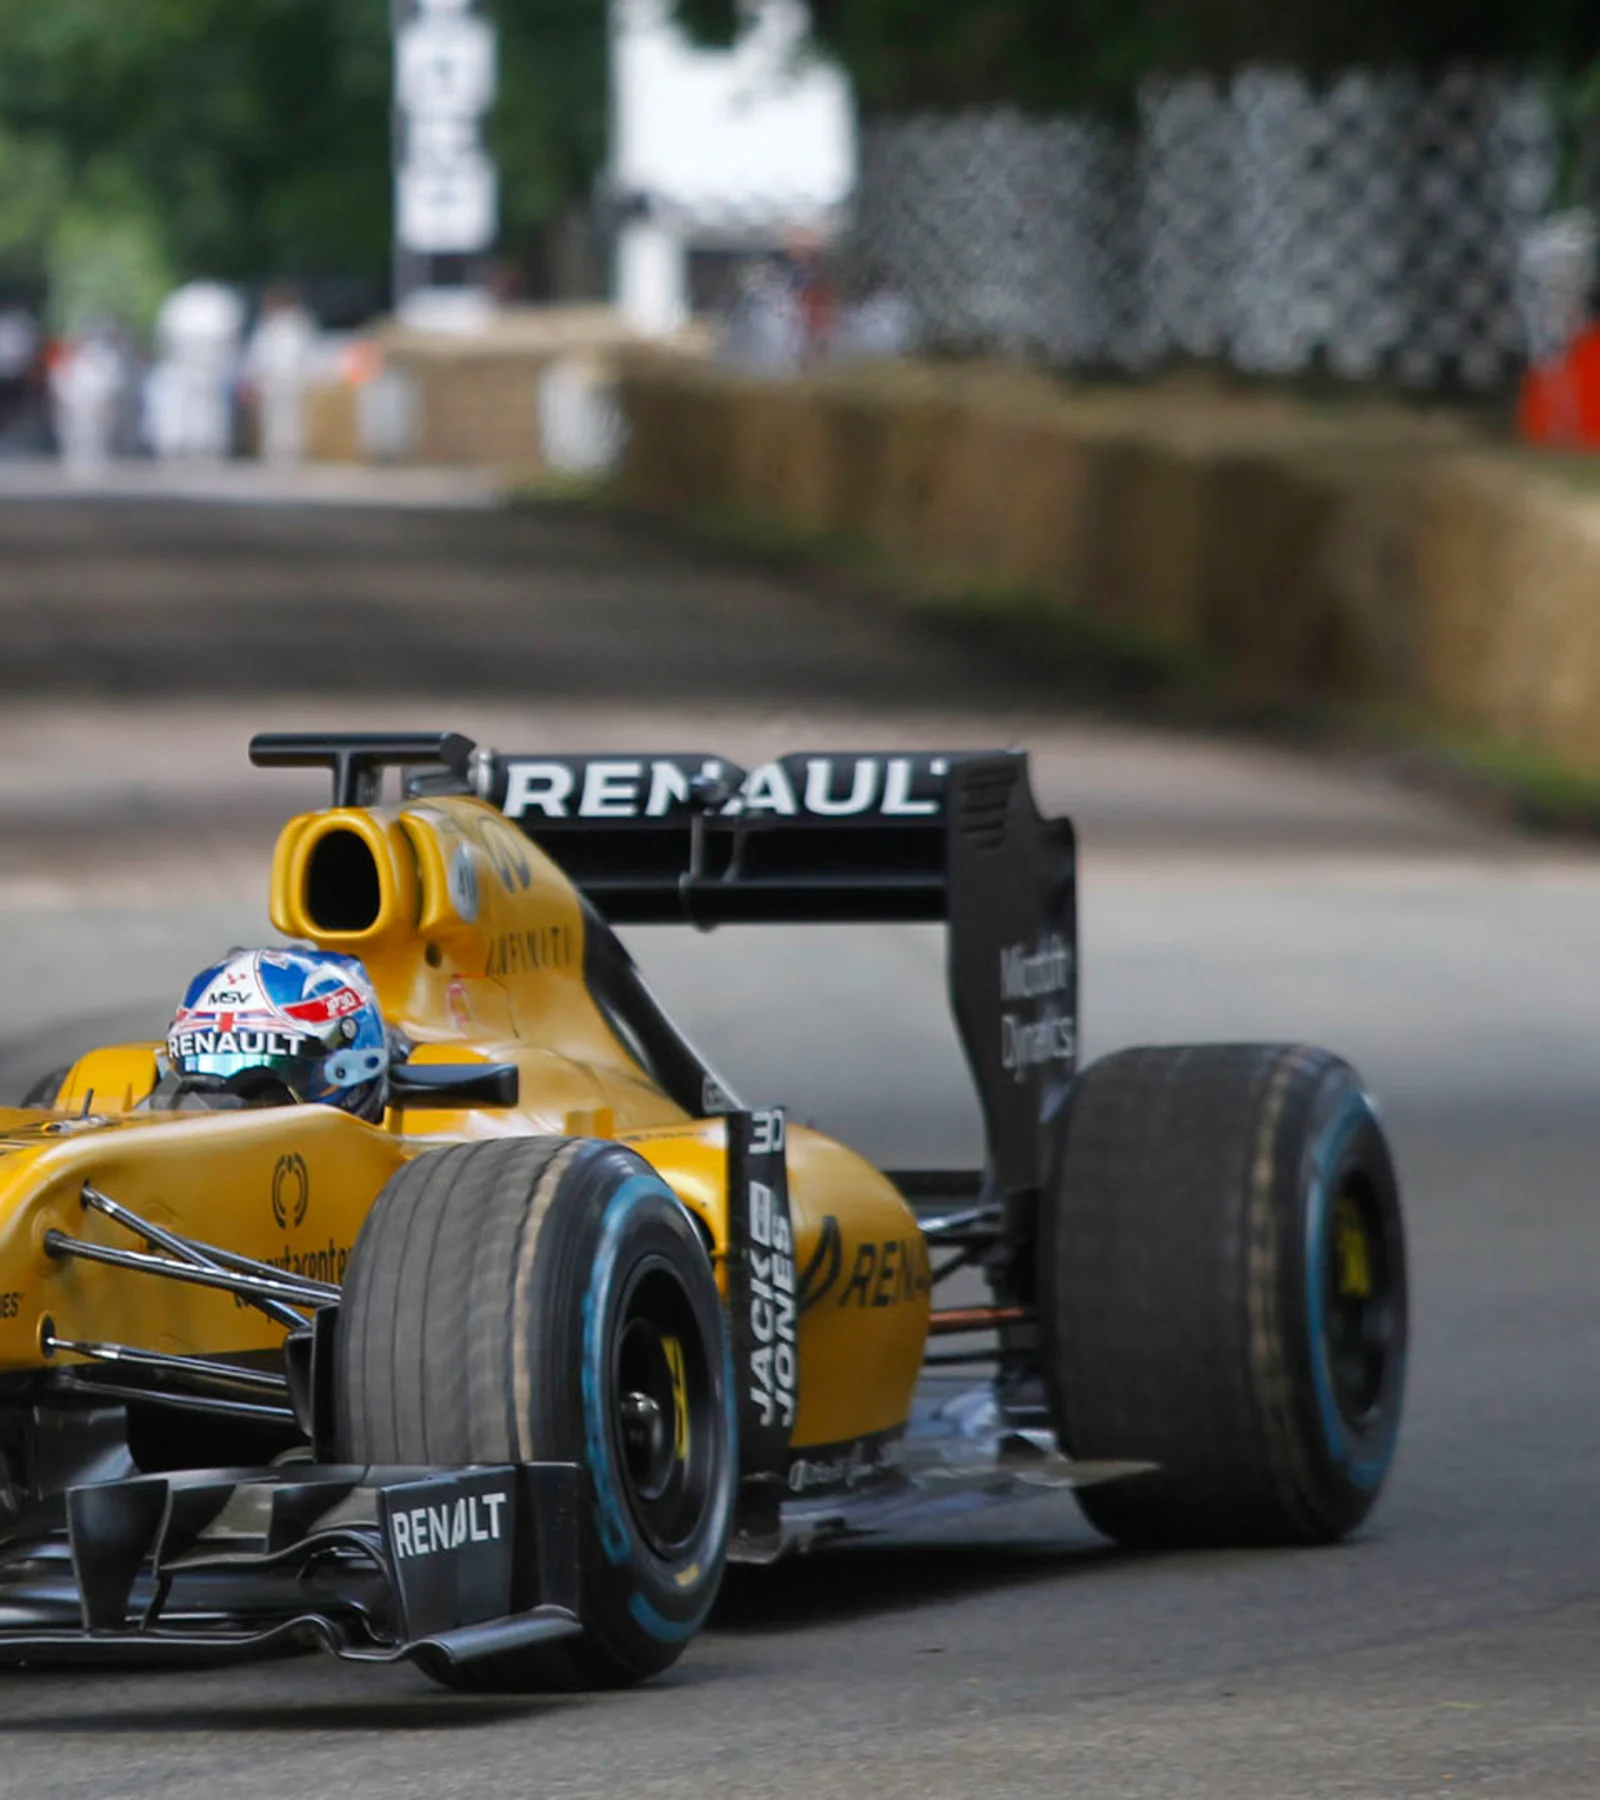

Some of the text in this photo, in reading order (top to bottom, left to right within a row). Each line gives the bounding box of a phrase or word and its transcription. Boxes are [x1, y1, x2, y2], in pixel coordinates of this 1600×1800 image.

[504, 758, 949, 818] RENAUL
[208, 991, 251, 1005] MSV
[168, 1032, 306, 1058] RENAULT
